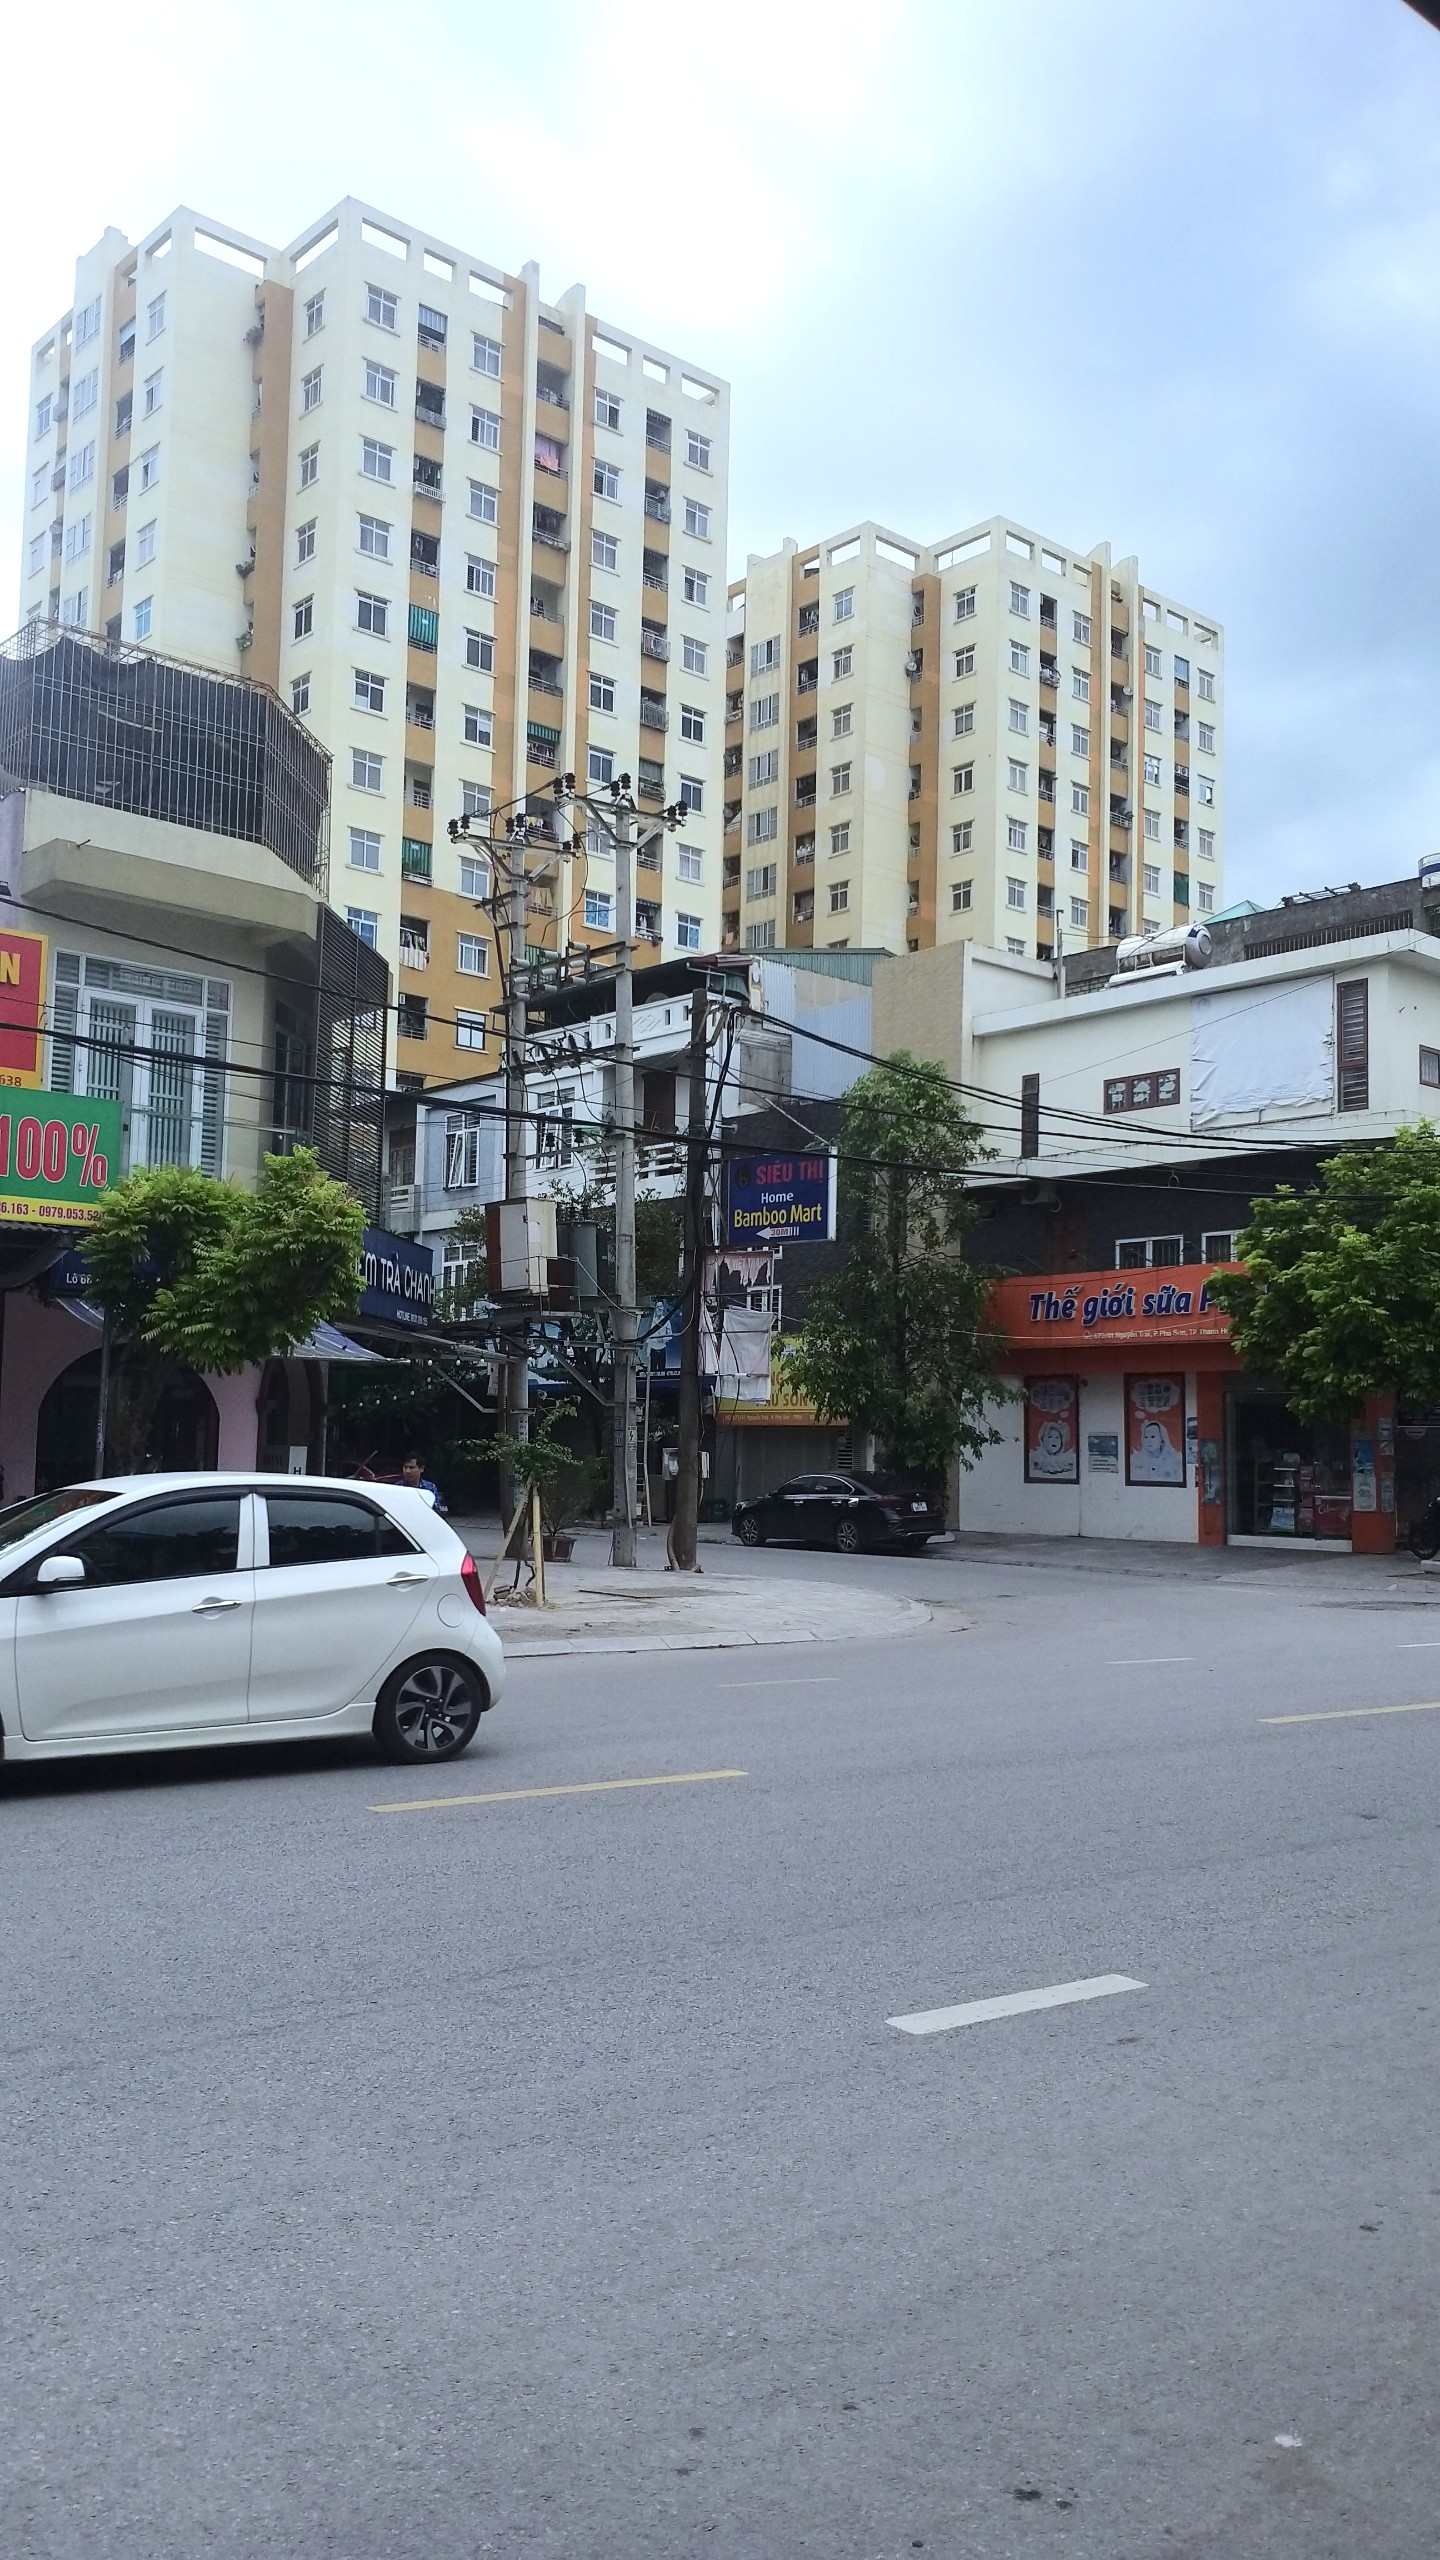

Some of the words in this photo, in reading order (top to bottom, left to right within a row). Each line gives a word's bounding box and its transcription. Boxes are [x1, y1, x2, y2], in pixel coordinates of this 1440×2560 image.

[0, 1114, 108, 1188] 100%
[0, 1202, 29, 1215] 6.163
[761, 1192, 794, 1204] Home
[734, 1206, 787, 1228] Bamboo
[790, 1203, 822, 1223] Mart
[770, 1228, 788, 1236] 30M
[380, 1252, 401, 1295] TRÀ
[1030, 1285, 1083, 1321] Thế
[1082, 1283, 1136, 1326] giới
[1141, 1285, 1193, 1316] sữa
